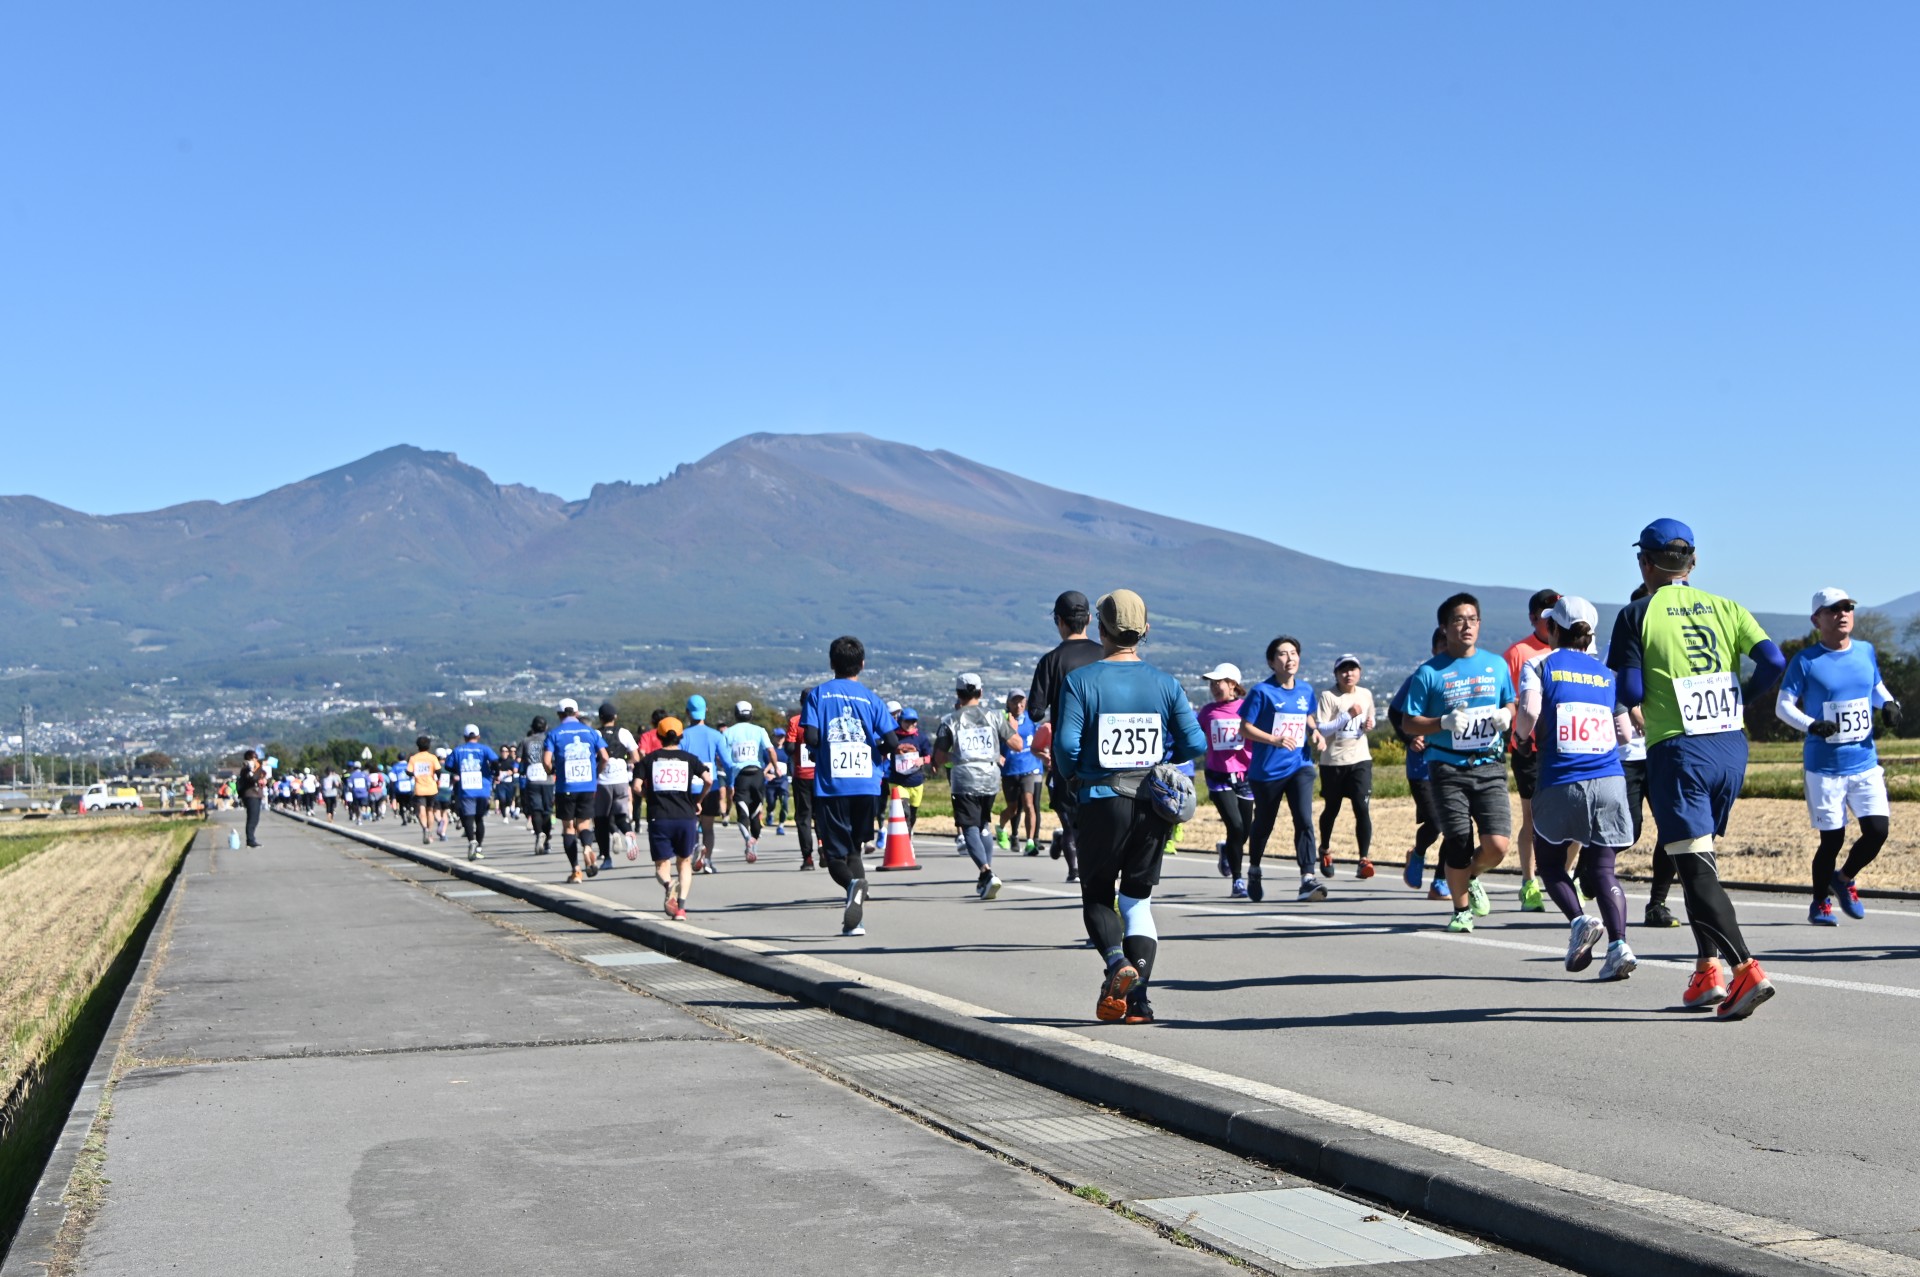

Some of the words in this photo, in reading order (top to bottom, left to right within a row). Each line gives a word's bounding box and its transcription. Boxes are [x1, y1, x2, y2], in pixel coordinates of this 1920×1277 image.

[1683, 686, 1739, 721] C2047
[961, 735, 992, 752] C2036
[1101, 728, 1159, 755] C2357
[832, 752, 868, 769] C2147
[654, 768, 687, 785] C2539
